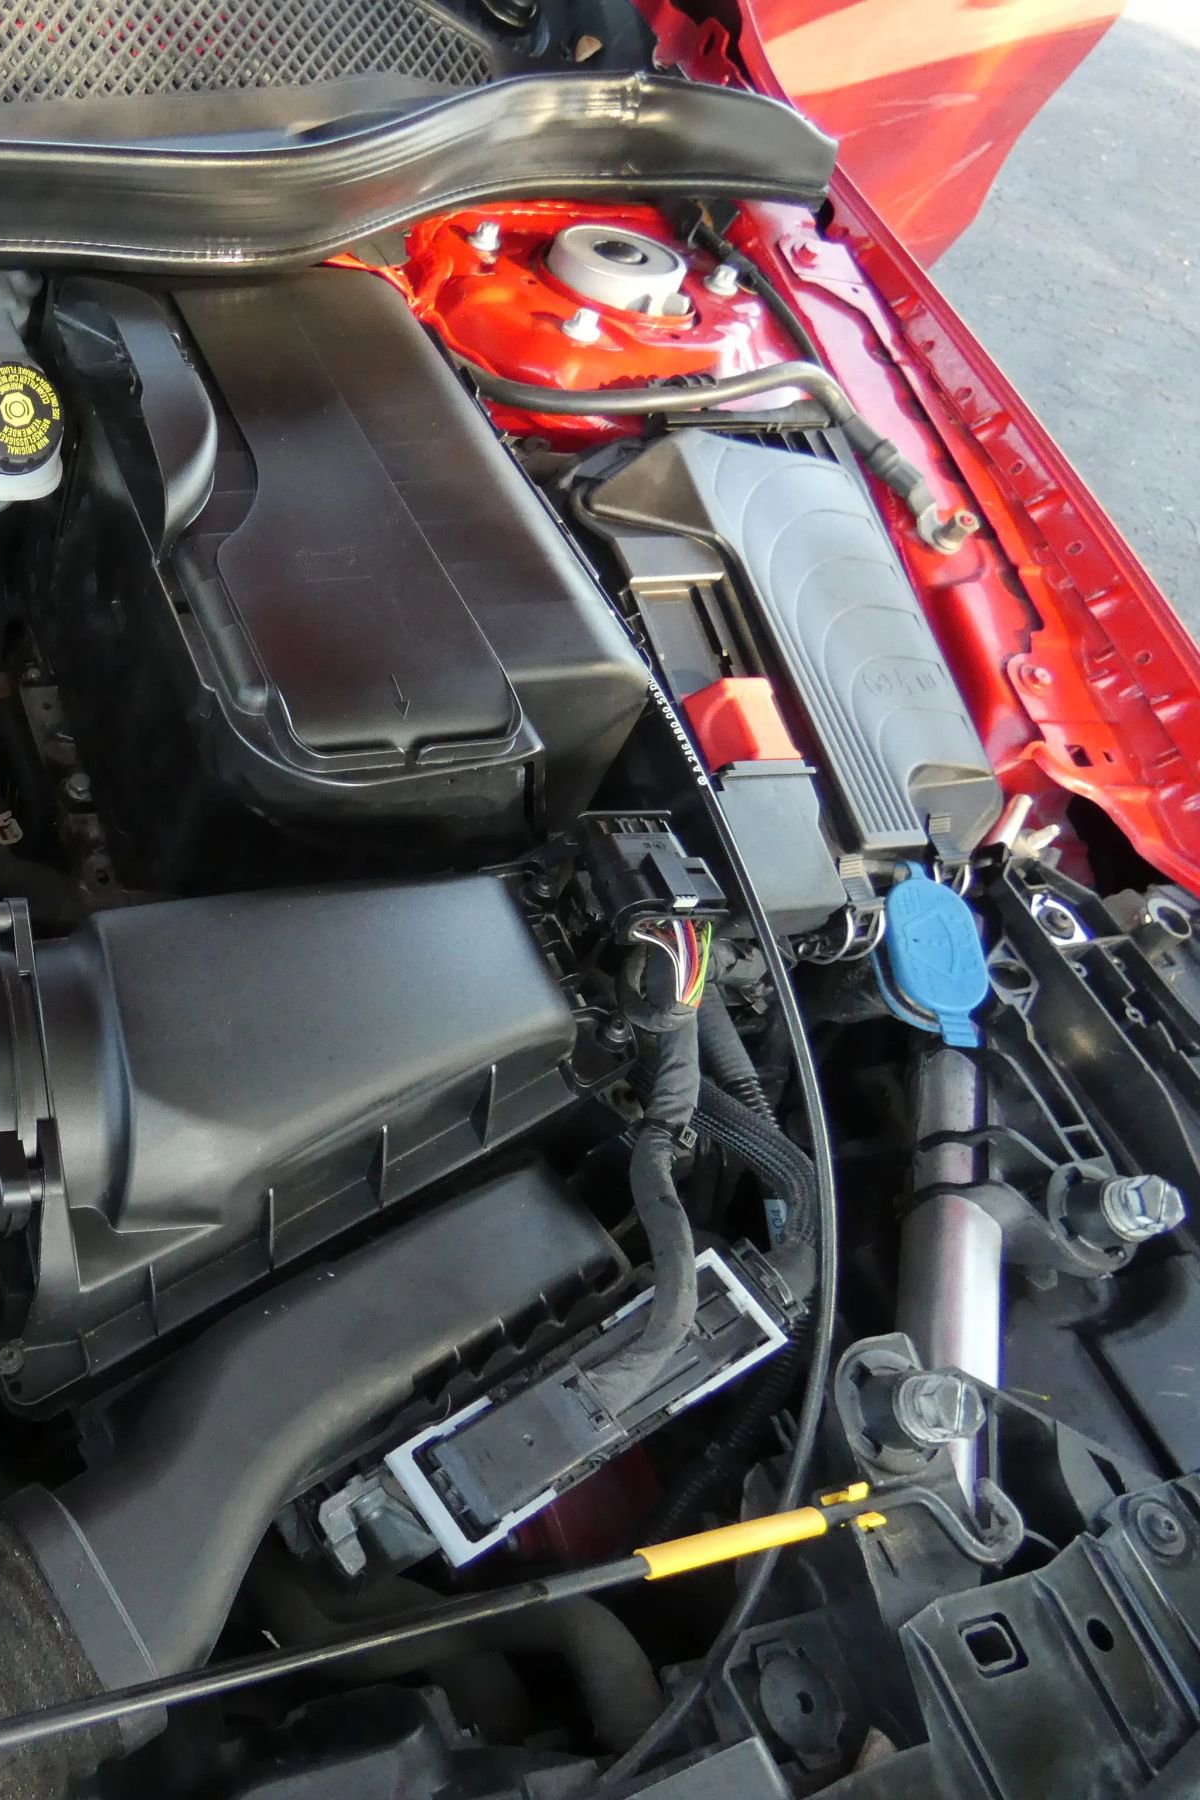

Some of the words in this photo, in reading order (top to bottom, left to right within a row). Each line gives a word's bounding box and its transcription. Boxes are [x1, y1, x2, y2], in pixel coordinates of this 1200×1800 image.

[0, 365, 17, 375] FLUID
[17, 366, 37, 378] BRAKE
[8, 374, 19, 382] CAP
[19, 374, 39, 389] FILLER
[35, 385, 50, 404] CLEAN
[49, 391, 59, 408] ONLY
[52, 407, 60, 420] USE
[2, 418, 42, 437] VERWENDEN
[7, 444, 37, 455] ORIGINAL
[36, 435, 50, 450] NUR
[662, 705, 675, 720] 00
